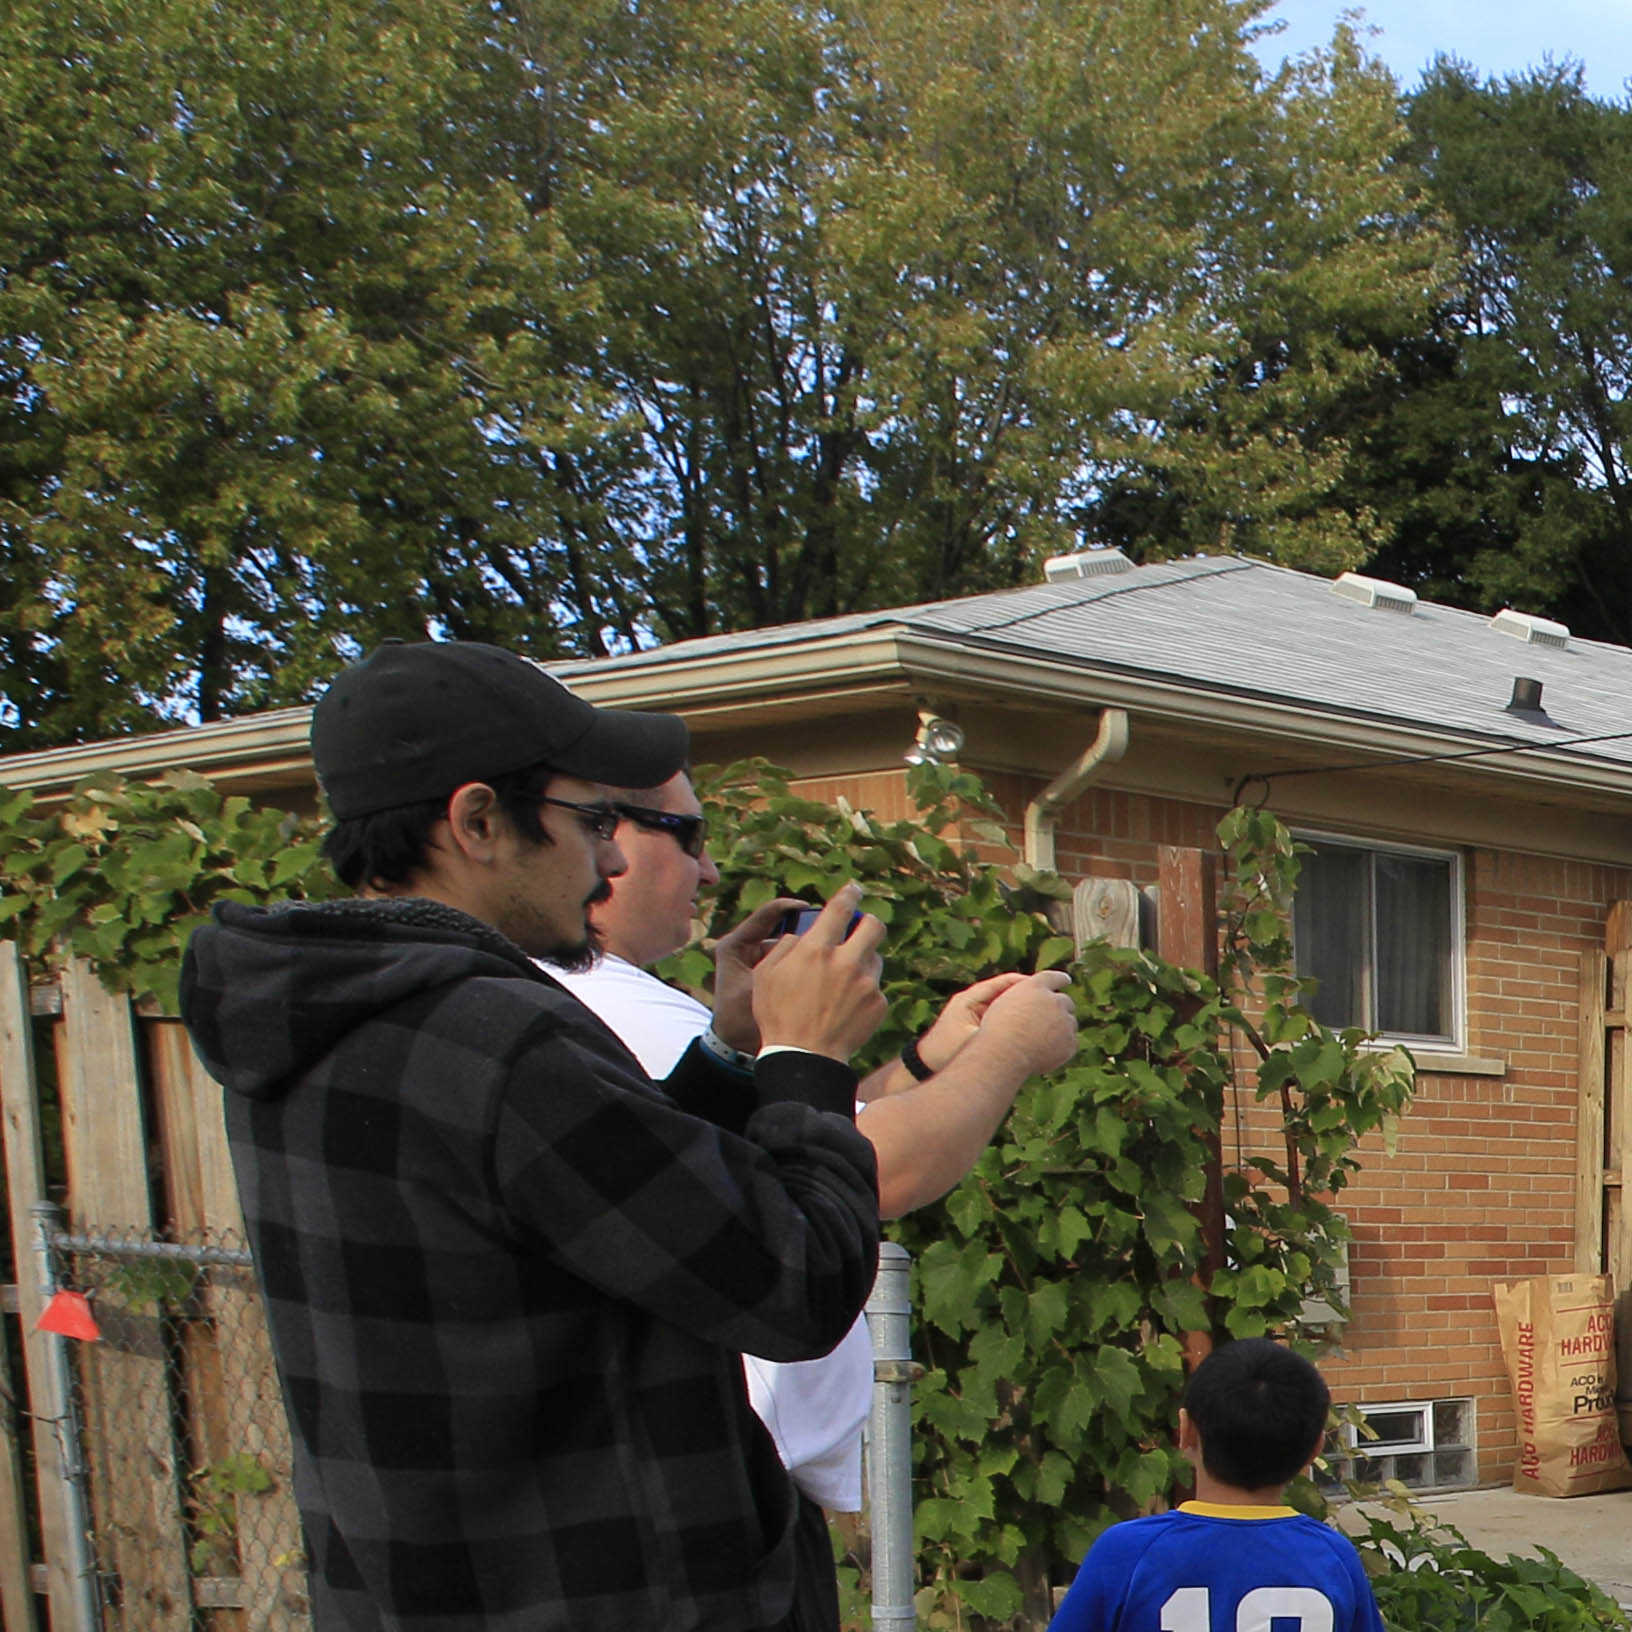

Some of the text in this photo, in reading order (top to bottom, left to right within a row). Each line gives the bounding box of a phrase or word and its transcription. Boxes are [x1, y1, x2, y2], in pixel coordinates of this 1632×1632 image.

[1518, 1321, 1541, 1480] ACO HARDWARE
[1570, 1375, 1595, 1387] ACO
